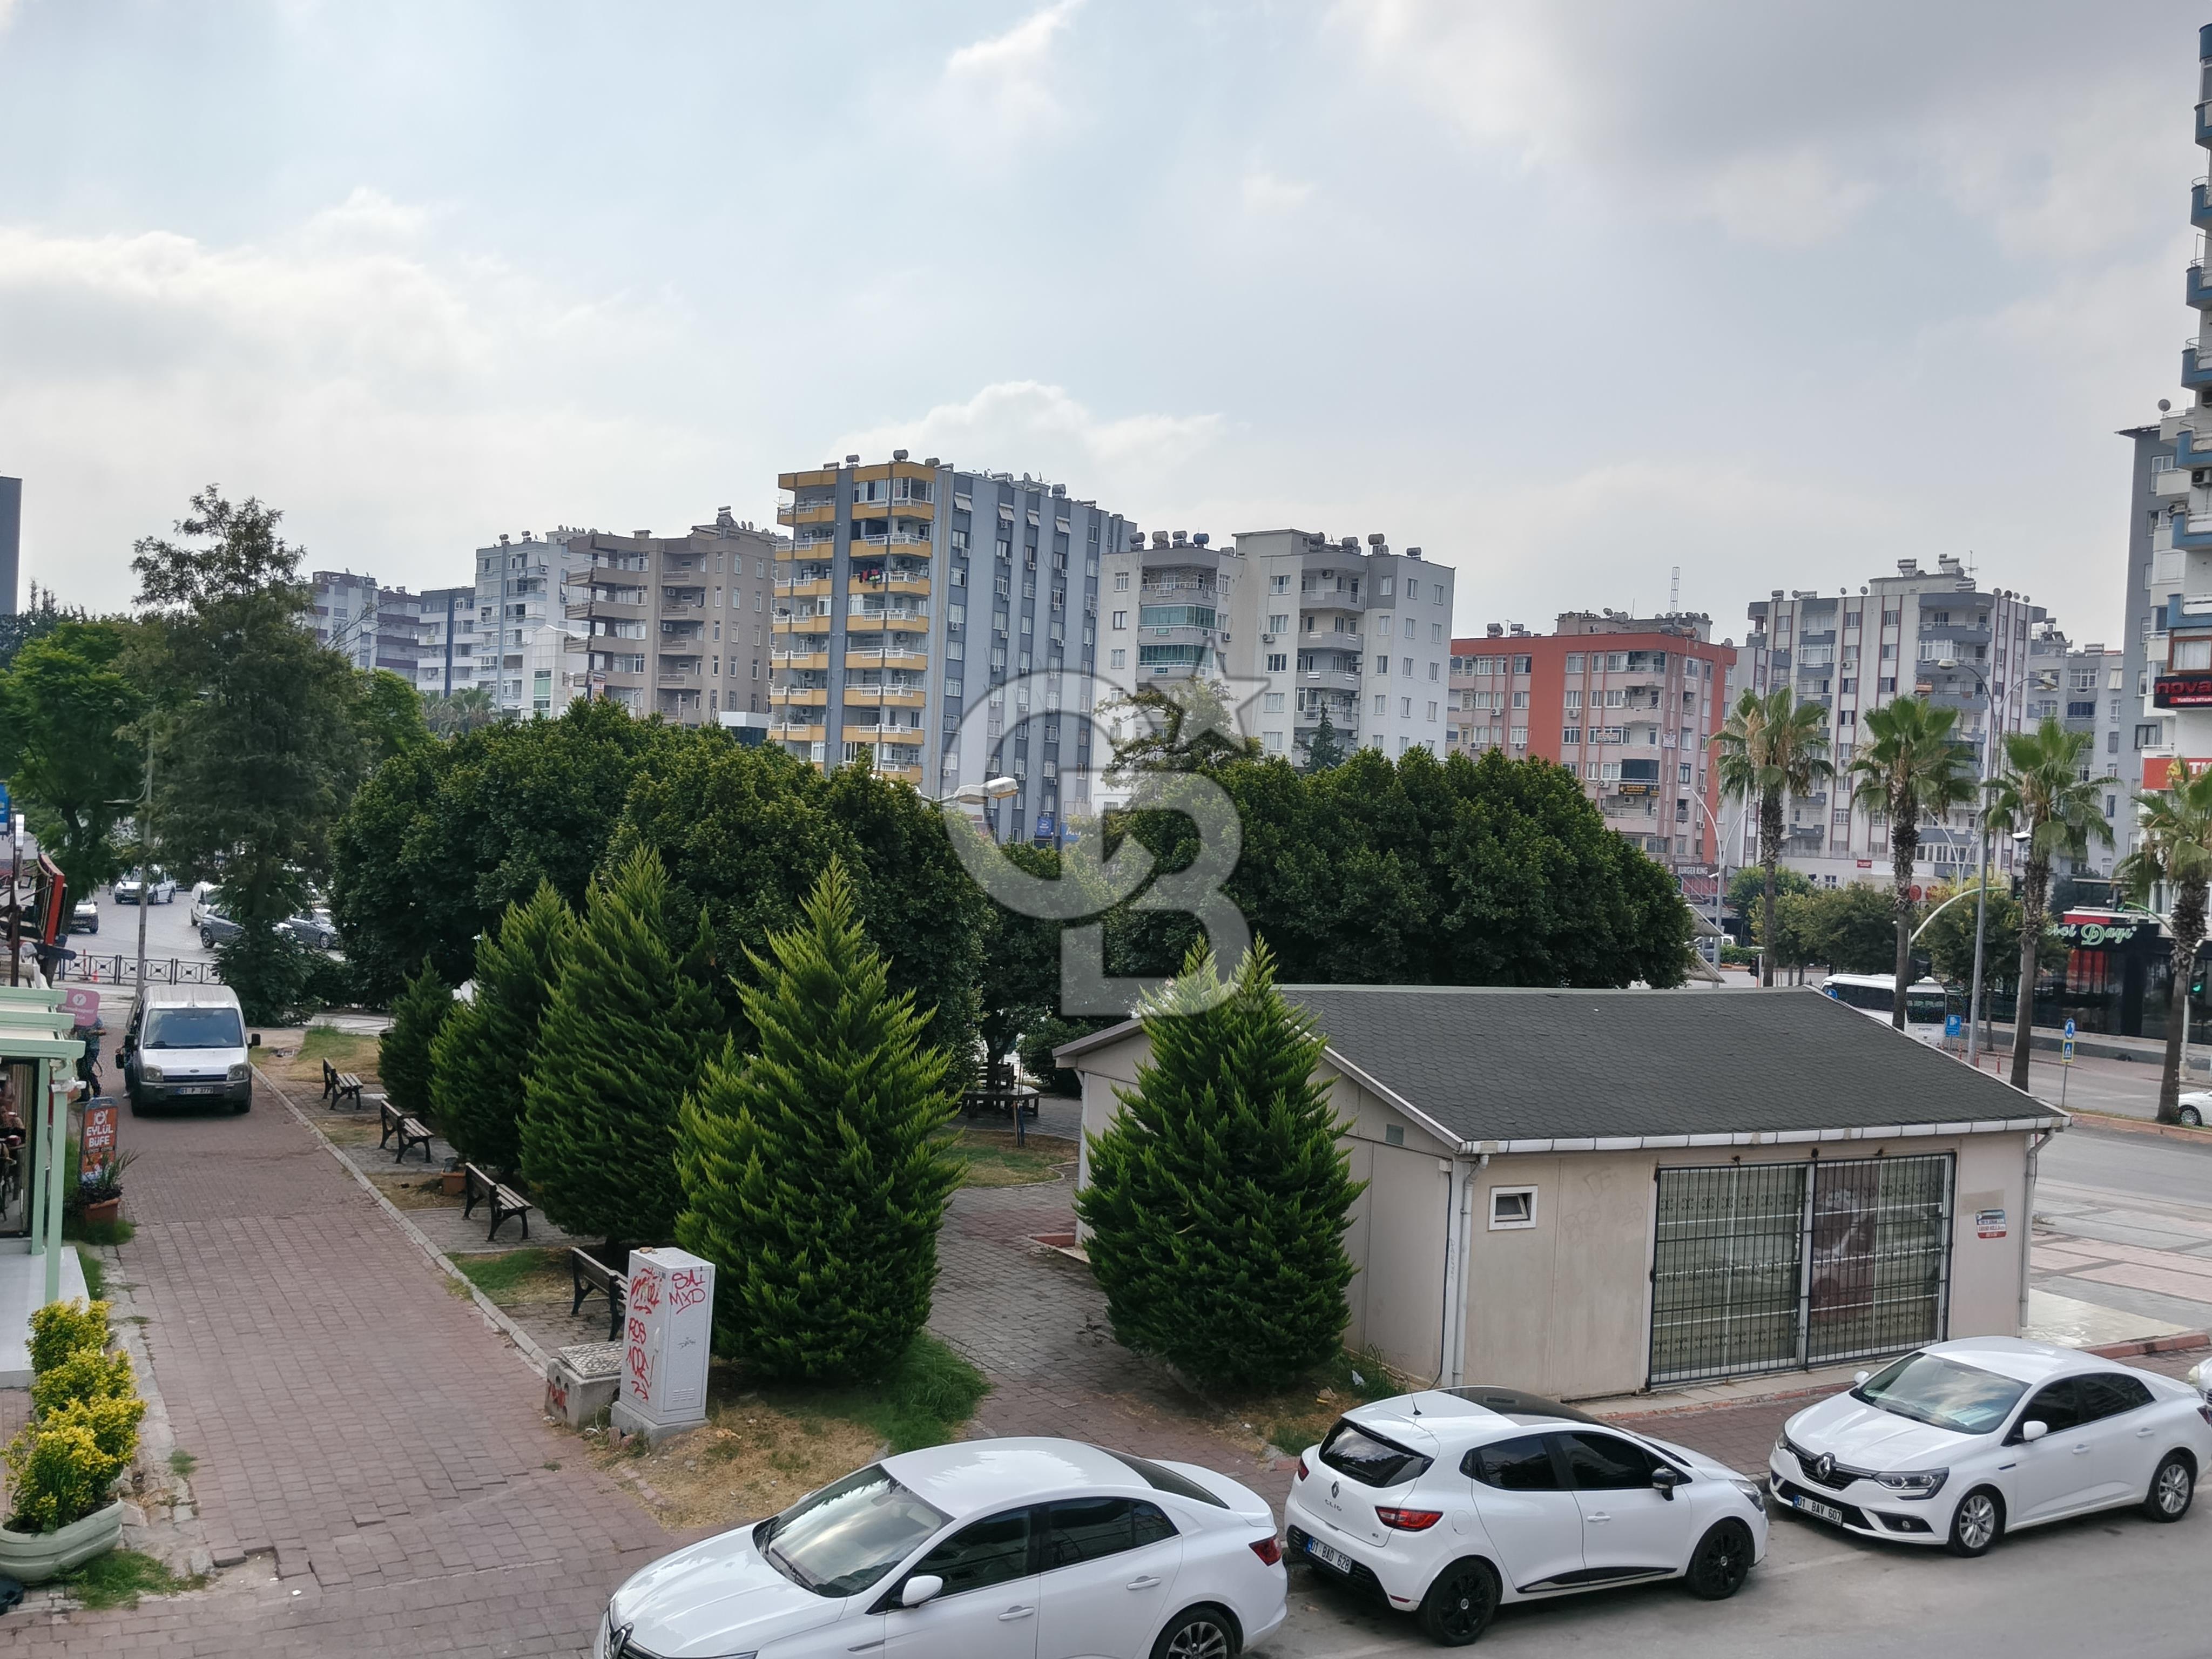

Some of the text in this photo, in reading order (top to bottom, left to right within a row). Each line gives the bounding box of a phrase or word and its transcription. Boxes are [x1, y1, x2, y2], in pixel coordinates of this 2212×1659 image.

[1678, 866, 1708, 875] BURGER KING
[86, 1123, 113, 1137] EYLÜL
[89, 1136, 110, 1148] BÜFE
[1325, 1499, 1343, 1512] CLIO
[1797, 1496, 1805, 1508] 01
[1828, 1508, 1841, 1521] 607
[1311, 1540, 1350, 1570] 01 BAD 628
